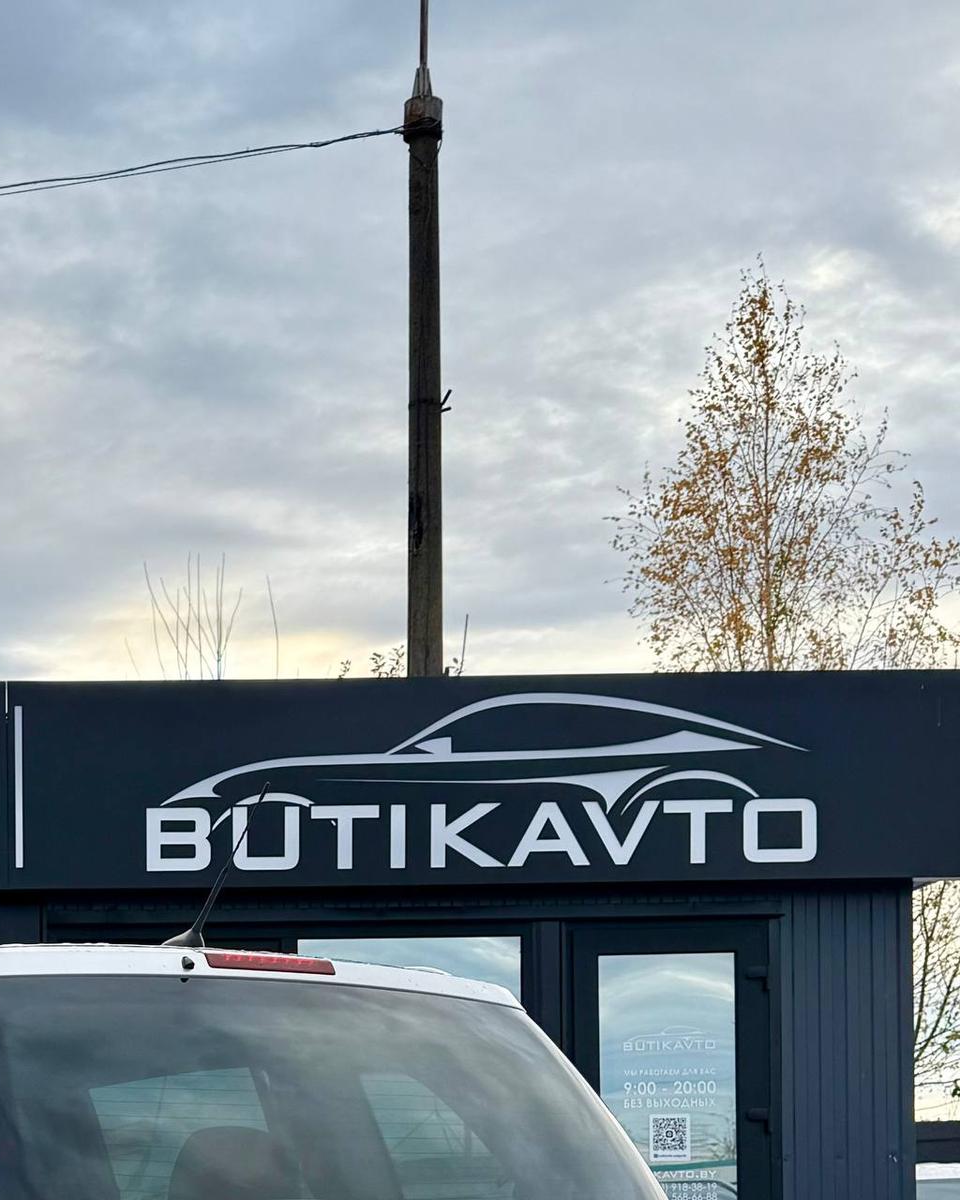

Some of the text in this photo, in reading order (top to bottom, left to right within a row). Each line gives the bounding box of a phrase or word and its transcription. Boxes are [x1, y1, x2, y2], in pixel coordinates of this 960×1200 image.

[146, 798, 818, 872] BUTIKAVTO
[623, 1039, 717, 1051] BUTIKAVTO
[623, 1081, 657, 1096] 9:00
[673, 1079, 717, 1095] 20:00
[623, 1097, 717, 1109] БЕЗ ВЫХОДНЫХ
[671, 1183, 718, 1192] 918-38-19
